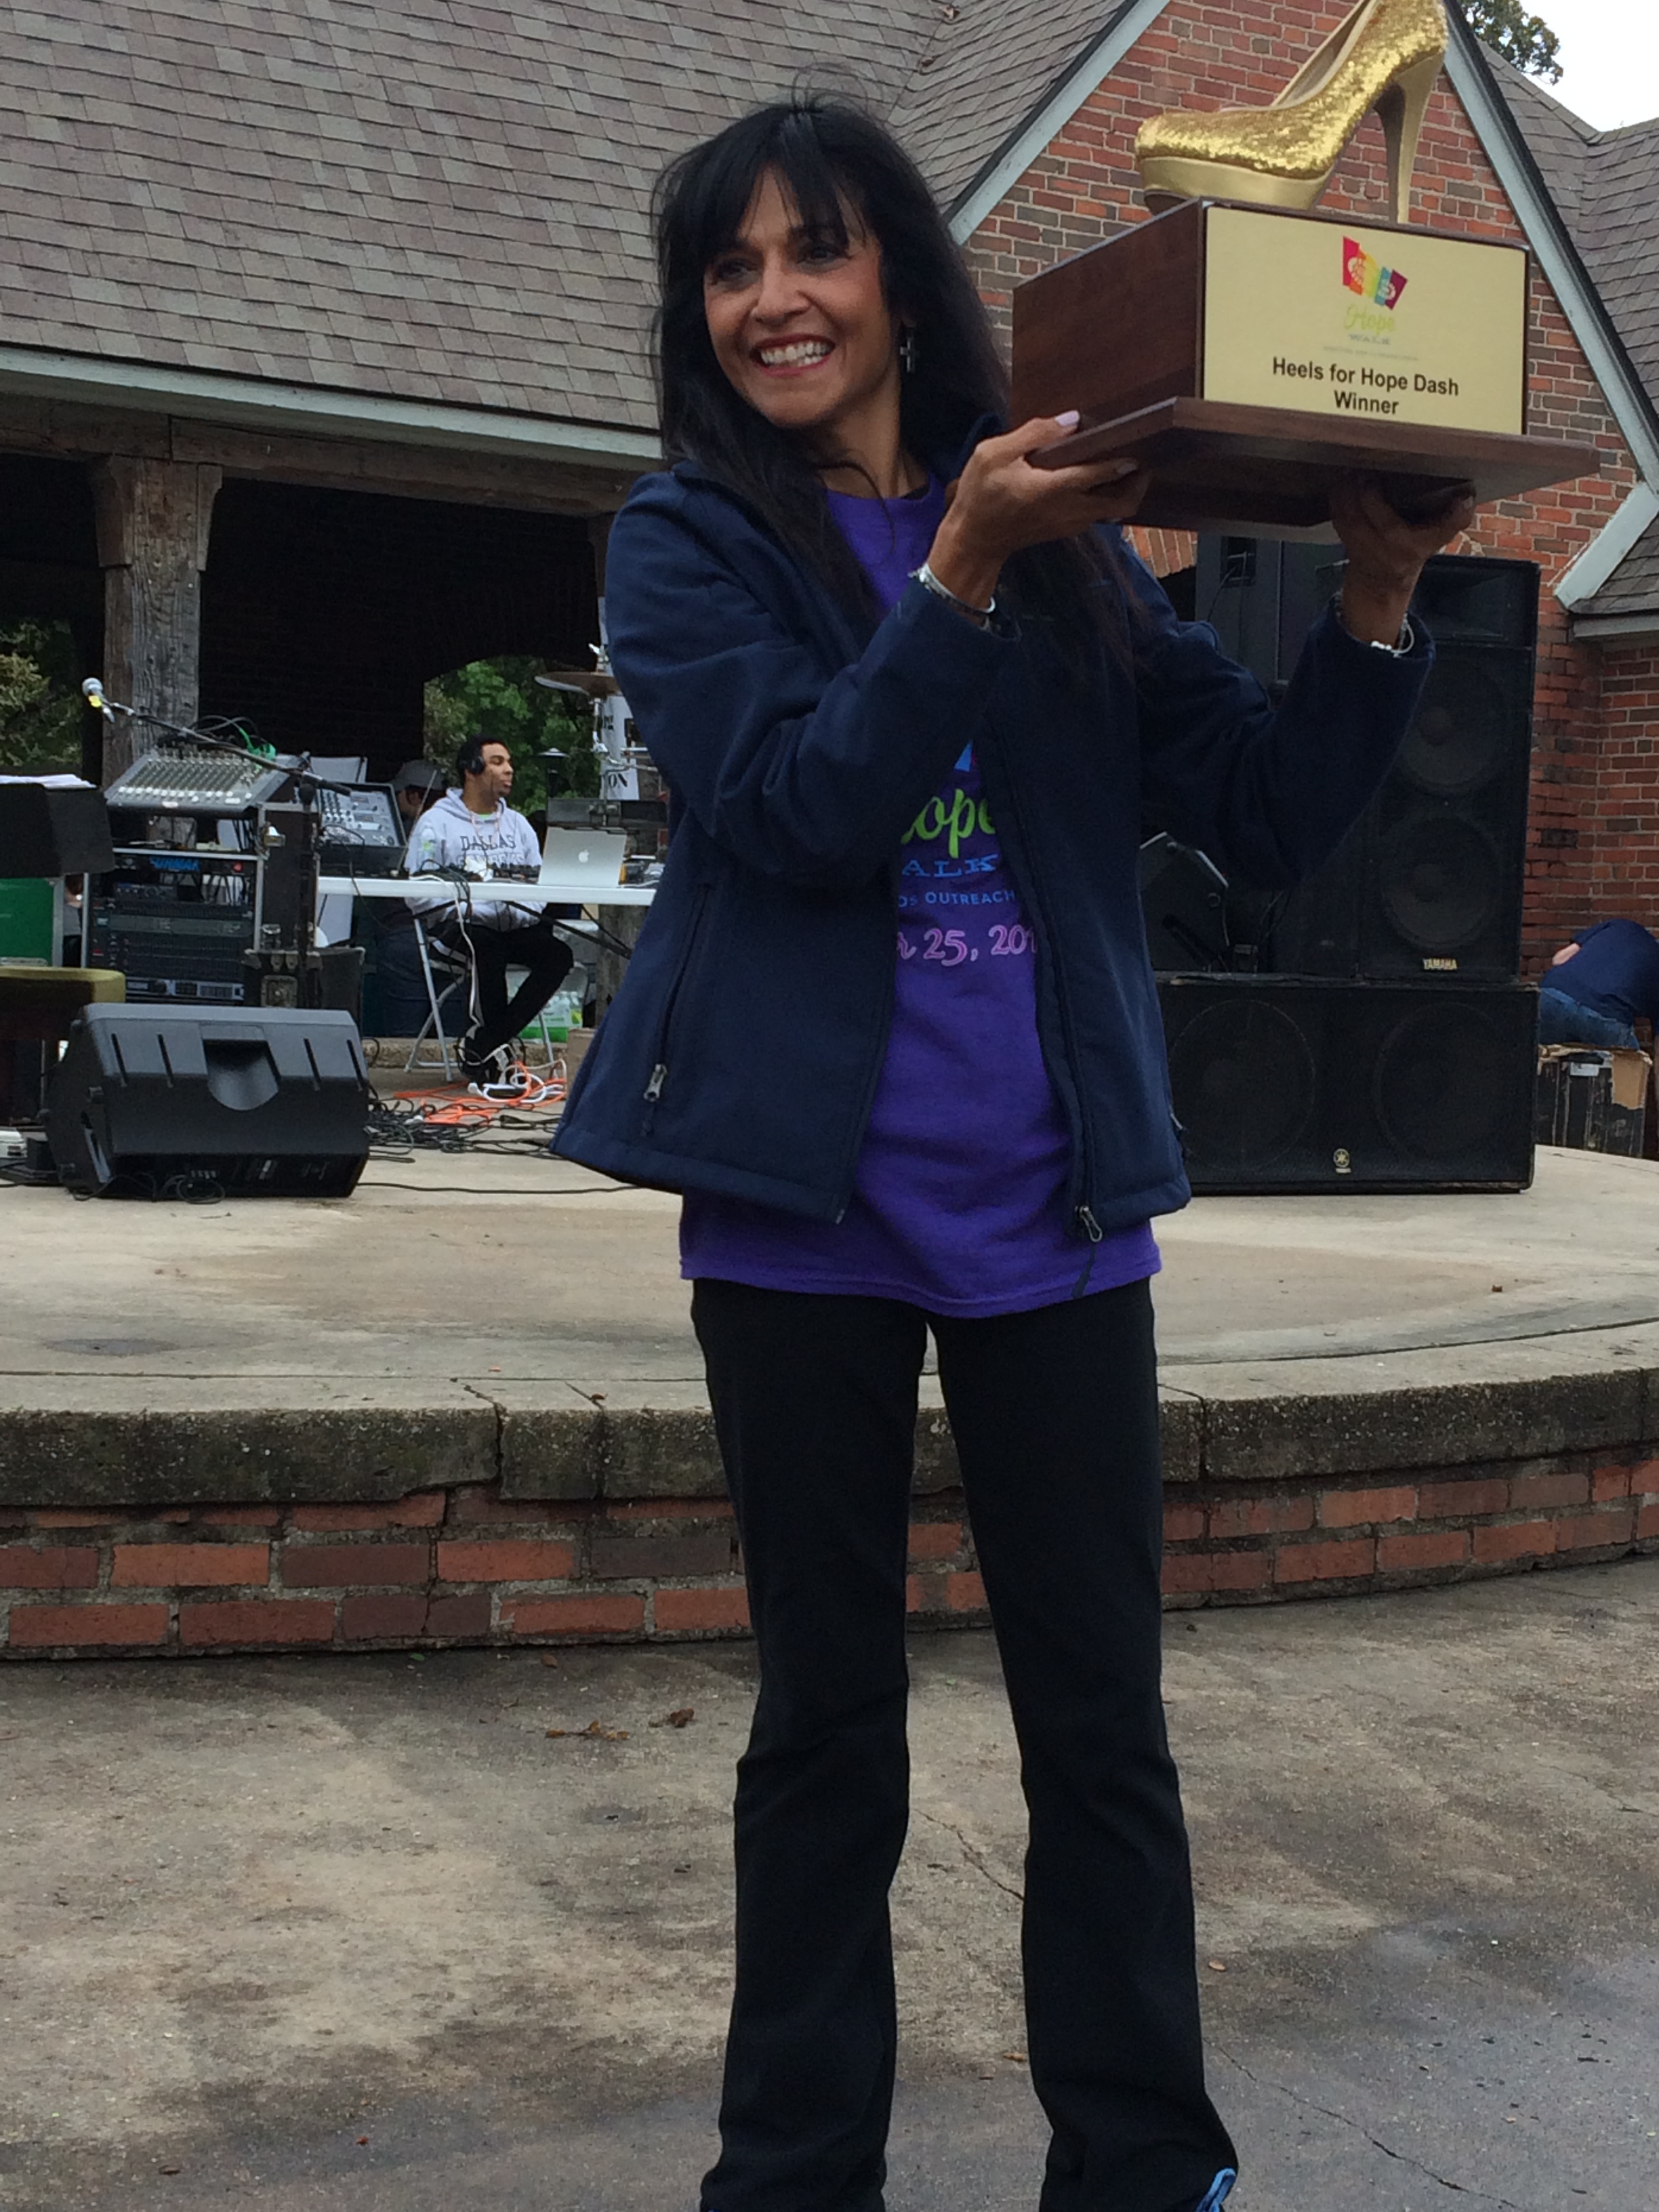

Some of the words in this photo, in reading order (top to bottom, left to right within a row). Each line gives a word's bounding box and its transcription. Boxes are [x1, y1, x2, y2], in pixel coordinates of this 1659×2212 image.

[1273, 356, 1324, 380] Heels
[1330, 363, 1355, 384] for
[1361, 367, 1408, 392] Hope
[1414, 373, 1458, 396] Dash
[1334, 390, 1399, 415] Winner
[460, 834, 516, 851] DALLAS
[901, 854, 998, 878] ALK
[924, 889, 1015, 905] OUTREACH
[923, 928, 979, 966] 25,
